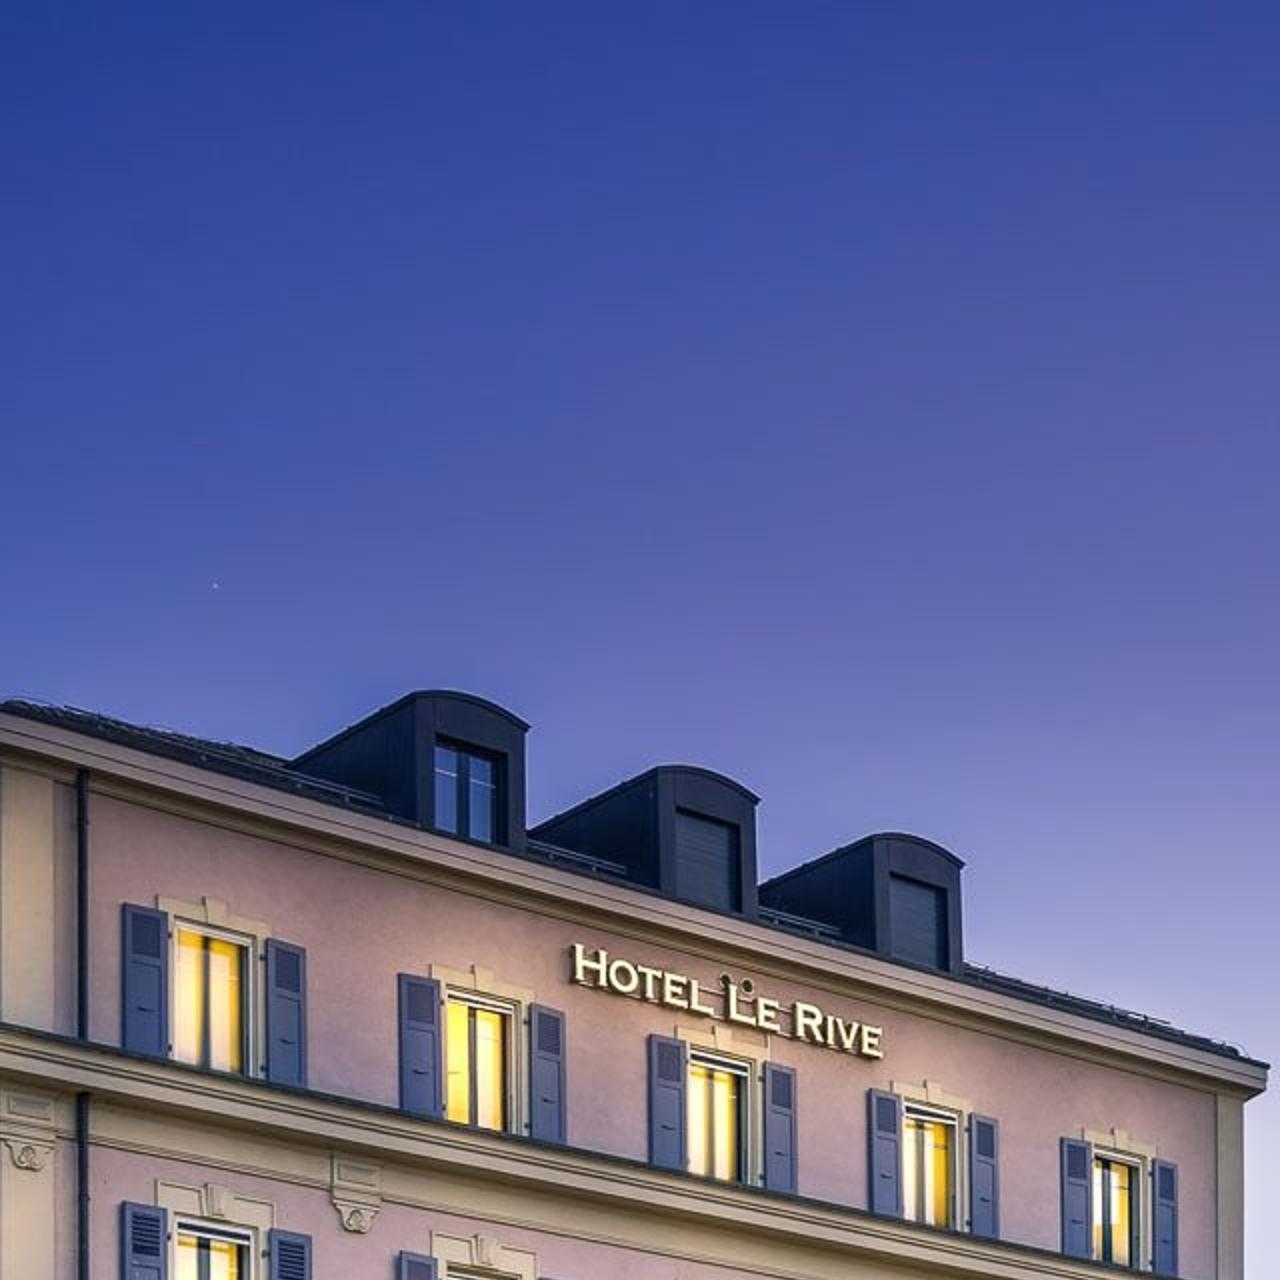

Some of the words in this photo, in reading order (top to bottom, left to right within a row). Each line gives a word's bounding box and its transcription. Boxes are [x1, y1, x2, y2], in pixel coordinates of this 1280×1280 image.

[573, 943, 715, 1015] HOTEL
[727, 983, 781, 1031] LE
[794, 1001, 883, 1058] RIVE
